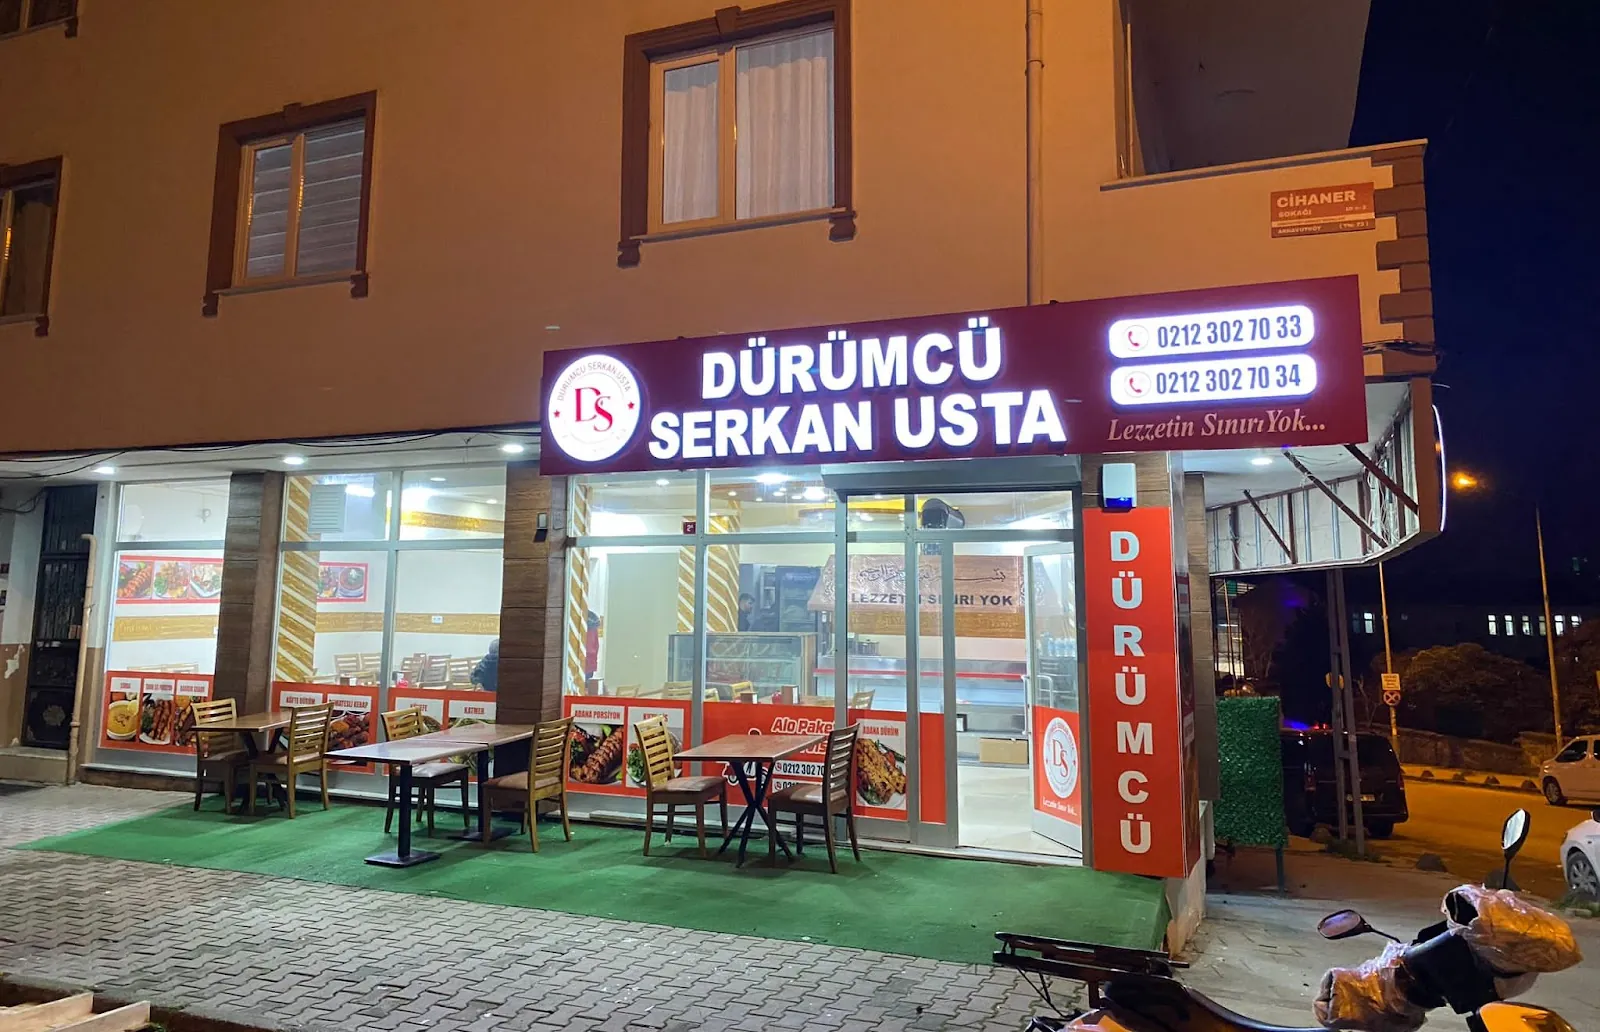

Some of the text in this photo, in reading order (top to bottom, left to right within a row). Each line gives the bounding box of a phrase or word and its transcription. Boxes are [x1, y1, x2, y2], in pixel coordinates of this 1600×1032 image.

[1277, 190, 1356, 208] CİHANER
[1278, 208, 1312, 218] SOKAĞI
[1157, 314, 1302, 348] 0212 302 70 33
[702, 317, 1002, 400] DÜRÜMCÜ
[1156, 364, 1301, 394] 0212 302 70 34
[575, 386, 613, 432] DS
[648, 389, 1067, 460] SERKAN USTA
[1108, 408, 1326, 441] Lezzetin Sınırı Yok...
[928, 594, 974, 605] SIIRI
[979, 595, 1013, 606] YOK
[1110, 531, 1153, 854] DÜRÜMCÜ
[771, 717, 835, 735] Alo Pake
[783, 763, 800, 774] 0212
[801, 764, 816, 775] 302
